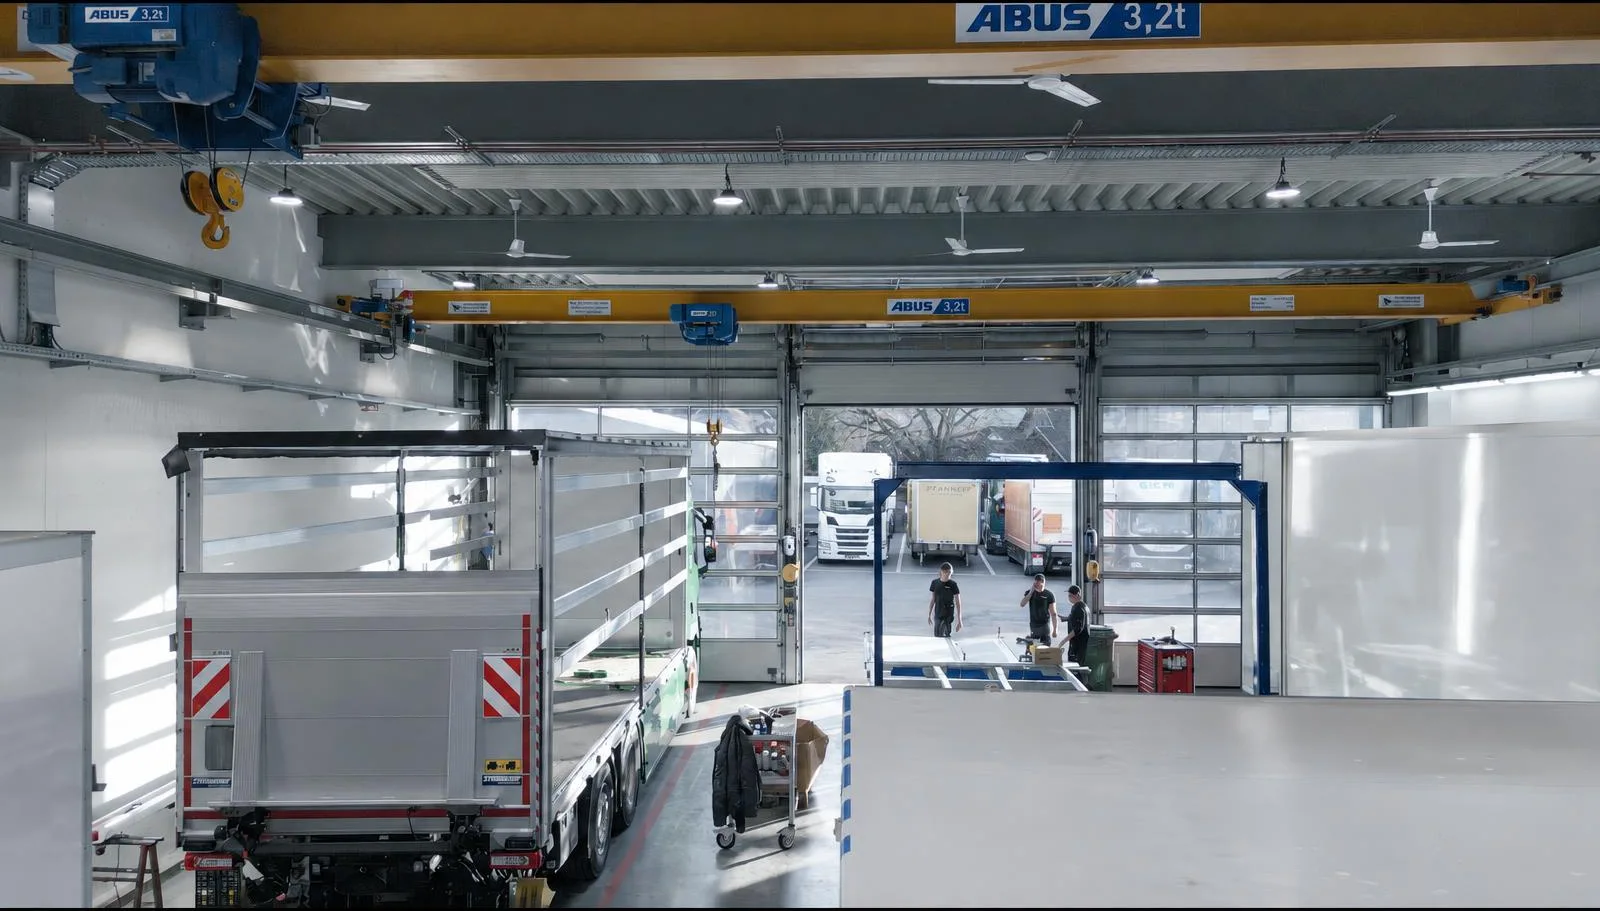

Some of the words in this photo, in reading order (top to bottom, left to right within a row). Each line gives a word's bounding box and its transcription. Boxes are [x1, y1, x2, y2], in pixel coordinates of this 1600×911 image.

[89, 10, 129, 20] ABUS
[141, 9, 163, 20] 3,2t
[966, 3, 1092, 32] ABUS
[1123, 3, 1186, 35] 3,2t
[891, 301, 933, 312] ABUS
[943, 301, 966, 313] 3,2t
